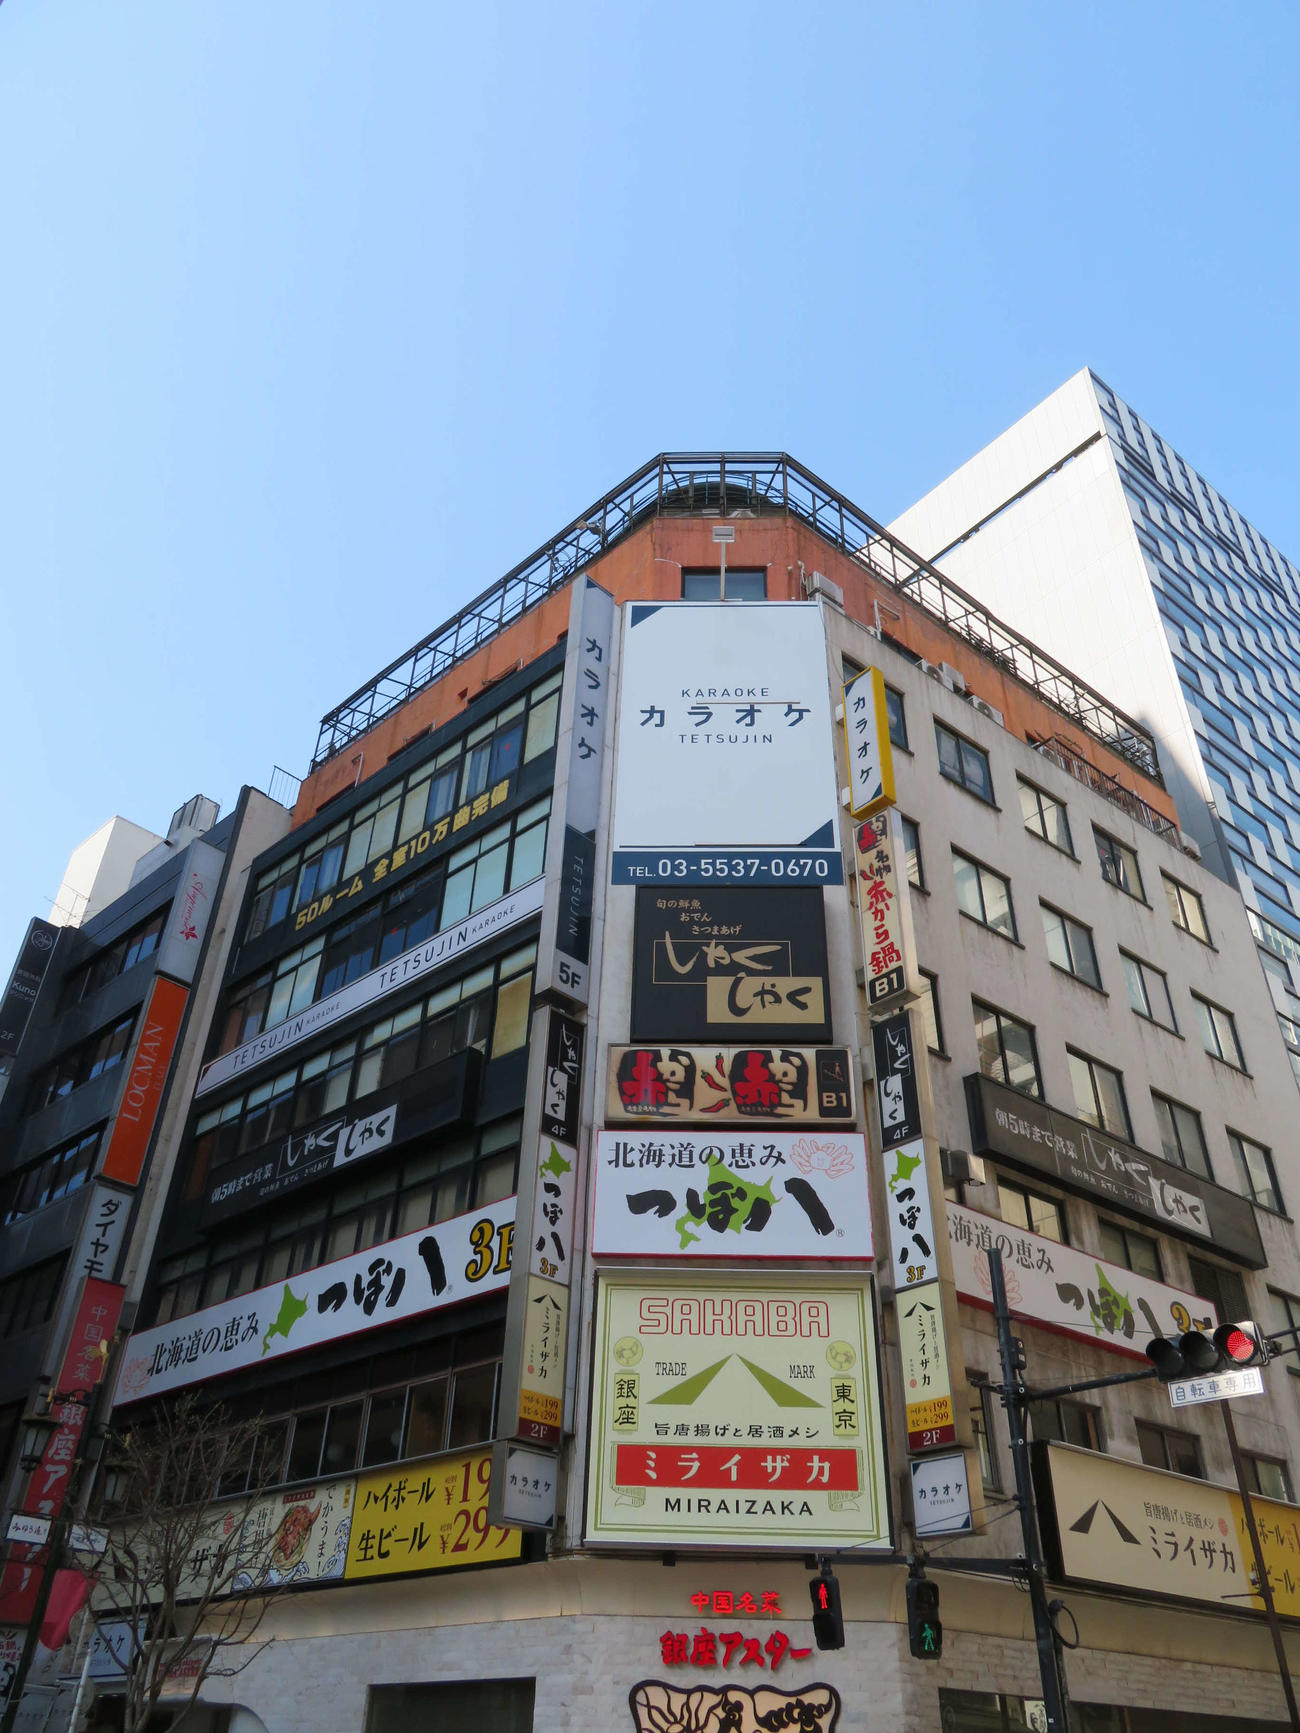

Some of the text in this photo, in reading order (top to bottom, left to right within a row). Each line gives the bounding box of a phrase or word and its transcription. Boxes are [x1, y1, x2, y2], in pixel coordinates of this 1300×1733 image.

[577, 636, 602, 761] カラオケ
[681, 687, 769, 698] KARAOKE
[639, 704, 812, 728] カラオケ
[679, 734, 773, 744] TETSUJIN
[853, 695, 873, 785] カラオケ
[627, 858, 829, 878] TEL. 03-5537-0670
[295, 879, 364, 931] 50ルーム
[566, 855, 584, 937] TETSUJIN
[656, 899, 702, 910] 旬の鮮魚
[679, 913, 713, 922] おでん
[691, 925, 742, 936] さつまあげ
[867, 878, 902, 977] 赤から鍋
[378, 904, 517, 989] TETSUJIN KARAOKE
[558, 964, 582, 990] 5F
[873, 972, 900, 998] B1
[232, 1018, 304, 1070] TETSUJIN
[122, 1023, 165, 1122] LOCMAN
[822, 1091, 848, 1108] B1
[551, 1124, 567, 1136] 4F
[893, 1126, 910, 1140] 4F
[607, 1141, 787, 1170] 北海道の恵み
[535, 1181, 566, 1262] つぼ八
[625, 1177, 836, 1237] つぼ八
[895, 1187, 932, 1264] つぼ八
[946, 1209, 1055, 1275] 海道の恵み
[317, 1235, 447, 1317] つぼ八
[539, 1257, 559, 1278] 3F
[906, 1264, 926, 1284] 3F
[639, 1297, 831, 1338] SAKABA
[147, 1310, 260, 1379] 北海道の恵み
[537, 1306, 551, 1379] ミライザカ
[916, 1314, 931, 1388] ミライザカ
[654, 1361, 816, 1379] TRADE MARK
[615, 1377, 638, 1427] 銀座
[1174, 1374, 1257, 1402] 自転車専用
[832, 1382, 857, 1431] 東京
[530, 1423, 548, 1438] 2F
[654, 1421, 821, 1441] 旨唐揚げと居酒メシ
[923, 1430, 941, 1446] 2F
[643, 1451, 832, 1484] ミライザカ
[362, 1477, 436, 1512] ハイボール
[509, 1474, 552, 1493] カラオケ
[918, 1482, 963, 1500] カラオケ
[664, 1498, 814, 1516] MIRAIZAKA
[1143, 1501, 1215, 1529] 旨唐揚げと居酒メシ
[355, 1521, 432, 1563] 生ビール
[1149, 1525, 1236, 1574] ミライザカ
[690, 1590, 783, 1614] 中国名菜
[659, 1627, 813, 1671] 銀座アスター
